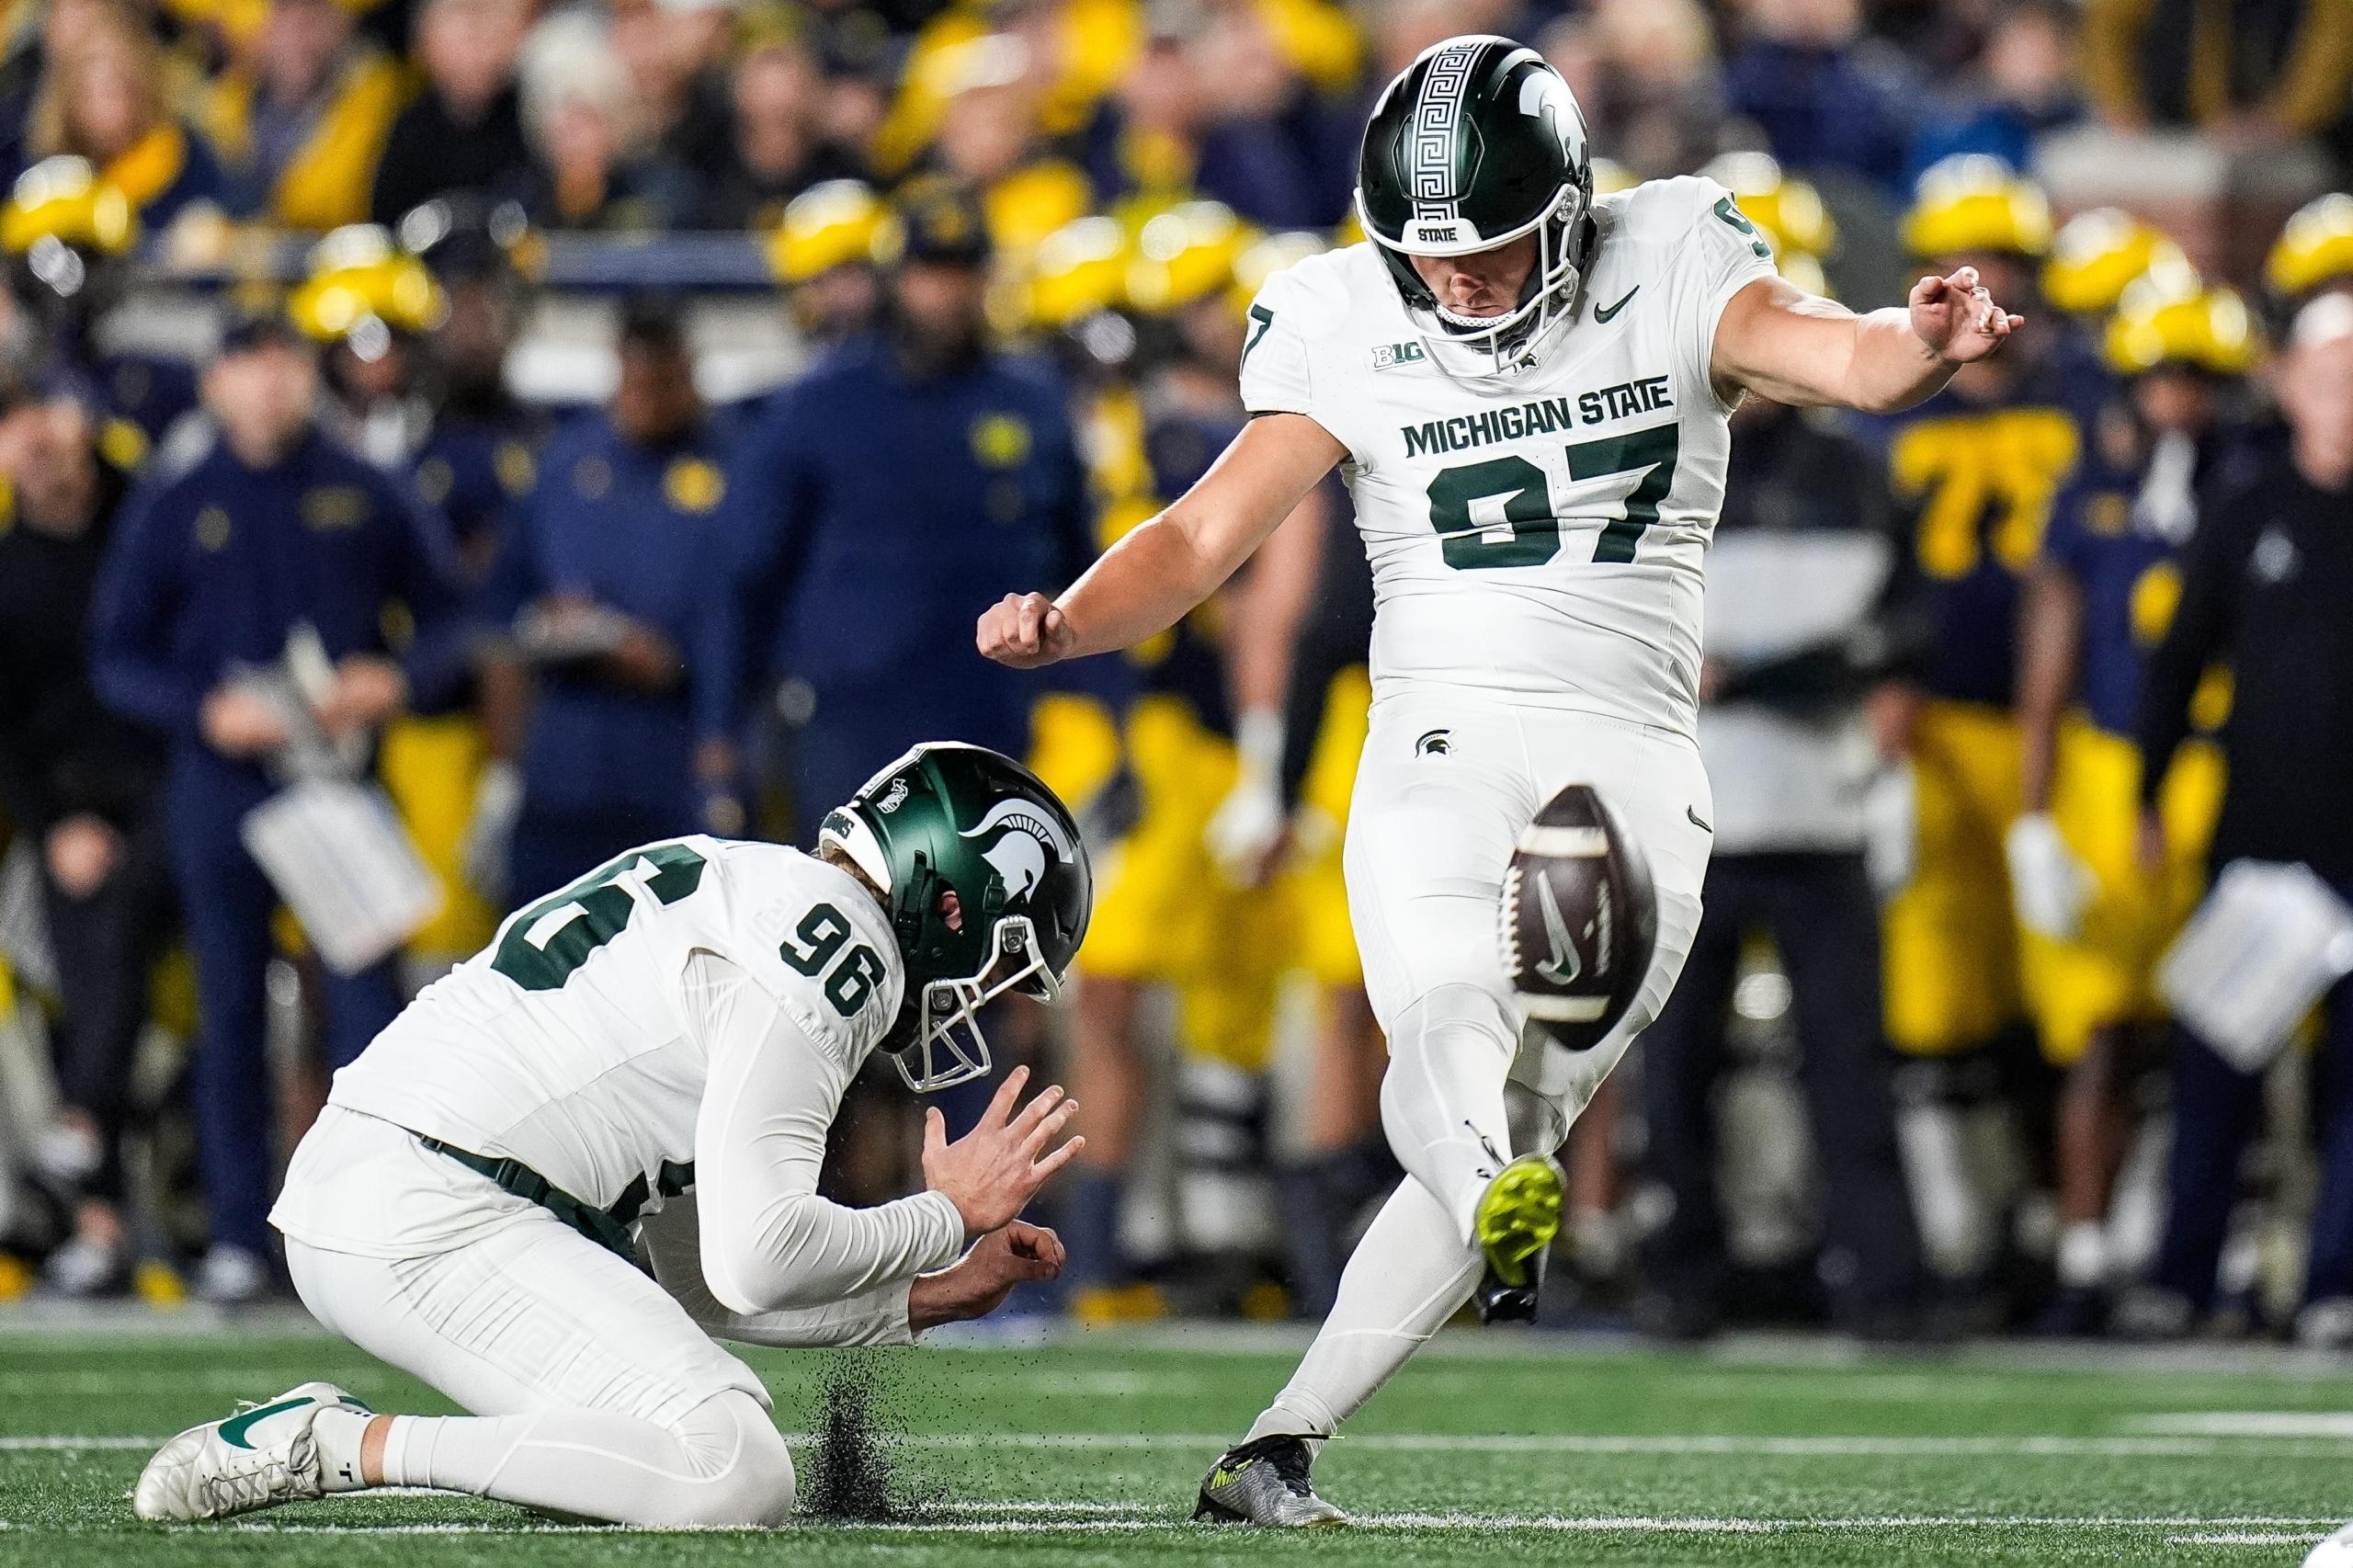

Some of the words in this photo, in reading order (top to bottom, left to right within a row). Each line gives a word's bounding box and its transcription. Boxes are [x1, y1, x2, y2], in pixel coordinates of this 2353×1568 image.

[1417, 227, 1458, 243] STATE
[1240, 302, 1275, 378] 7
[1400, 397, 1573, 458] MICHIGAN
[1578, 374, 1675, 425] STATE
[1426, 421, 1680, 571] 97
[779, 903, 887, 1017] 96
